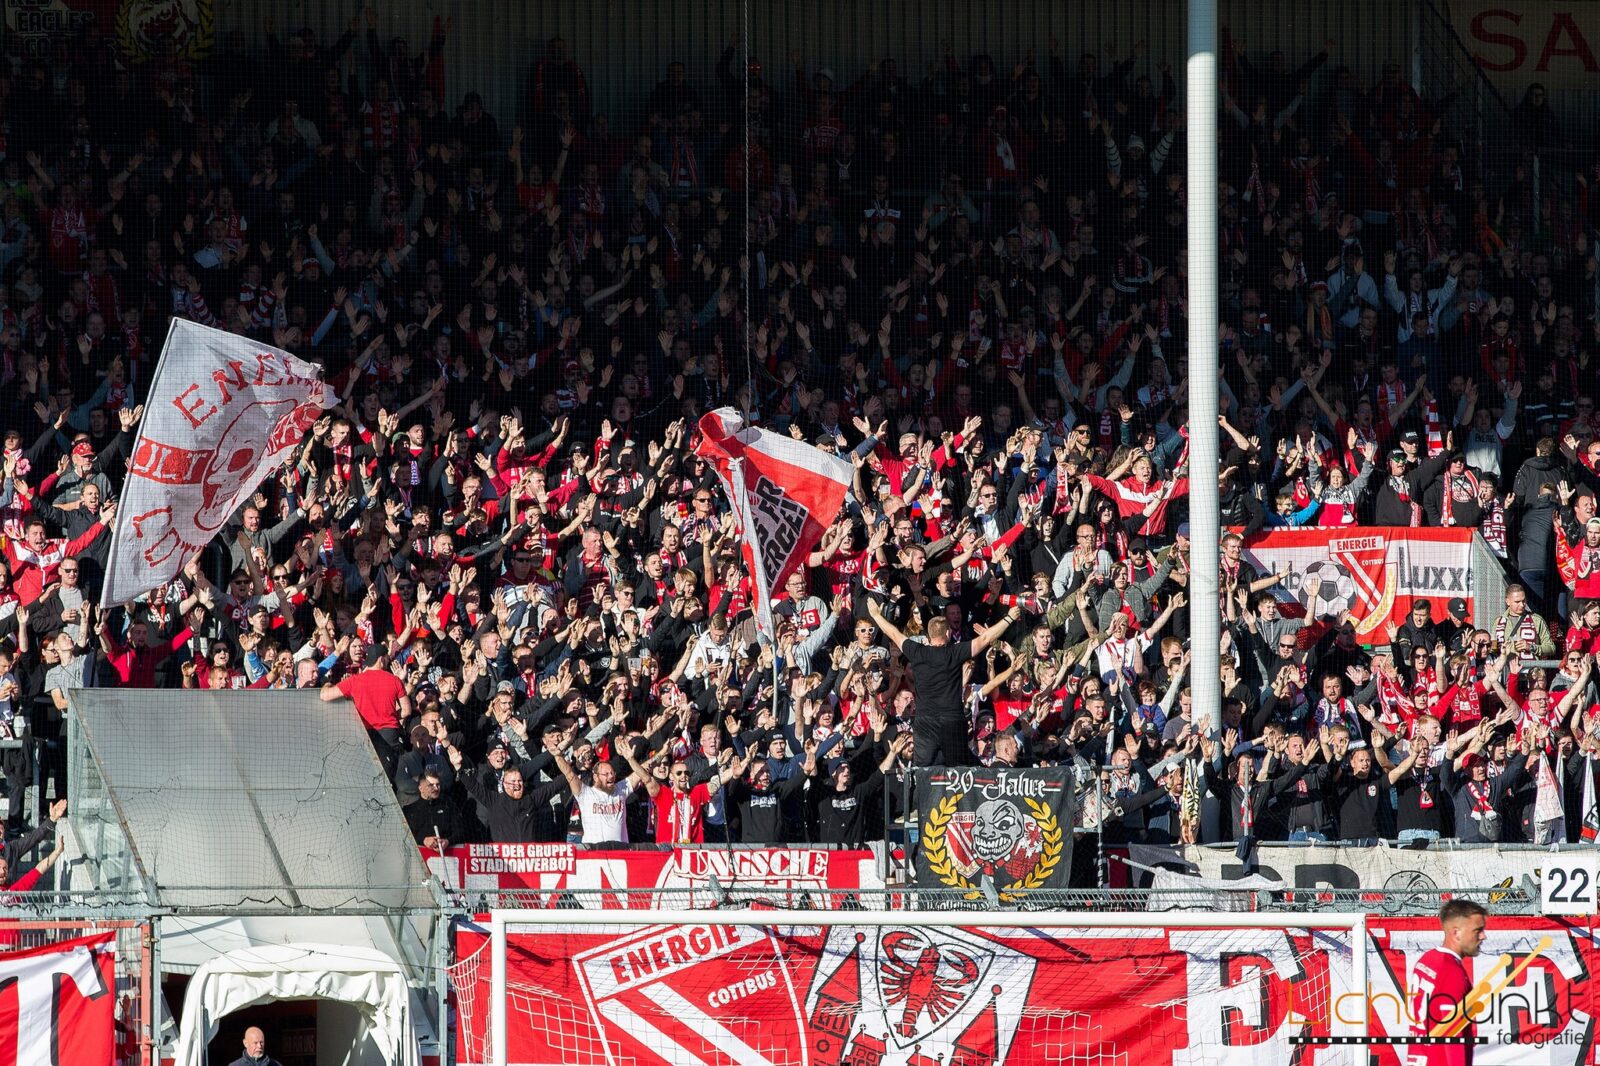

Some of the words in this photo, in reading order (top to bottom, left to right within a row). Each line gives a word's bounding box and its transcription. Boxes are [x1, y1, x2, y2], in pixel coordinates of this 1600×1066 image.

[1336, 538, 1377, 551] ENERGIE
[946, 770, 974, 793] 20
[981, 770, 1046, 800] Jahre
[469, 843, 499, 857] EHRE
[502, 843, 525, 857] DER
[527, 843, 573, 857] GRUPPE
[470, 858, 574, 873] STADIONVERBOT
[1547, 867, 1591, 903] 22
[610, 924, 742, 985] ENERGIE
[707, 970, 777, 1009] COTTBUS
